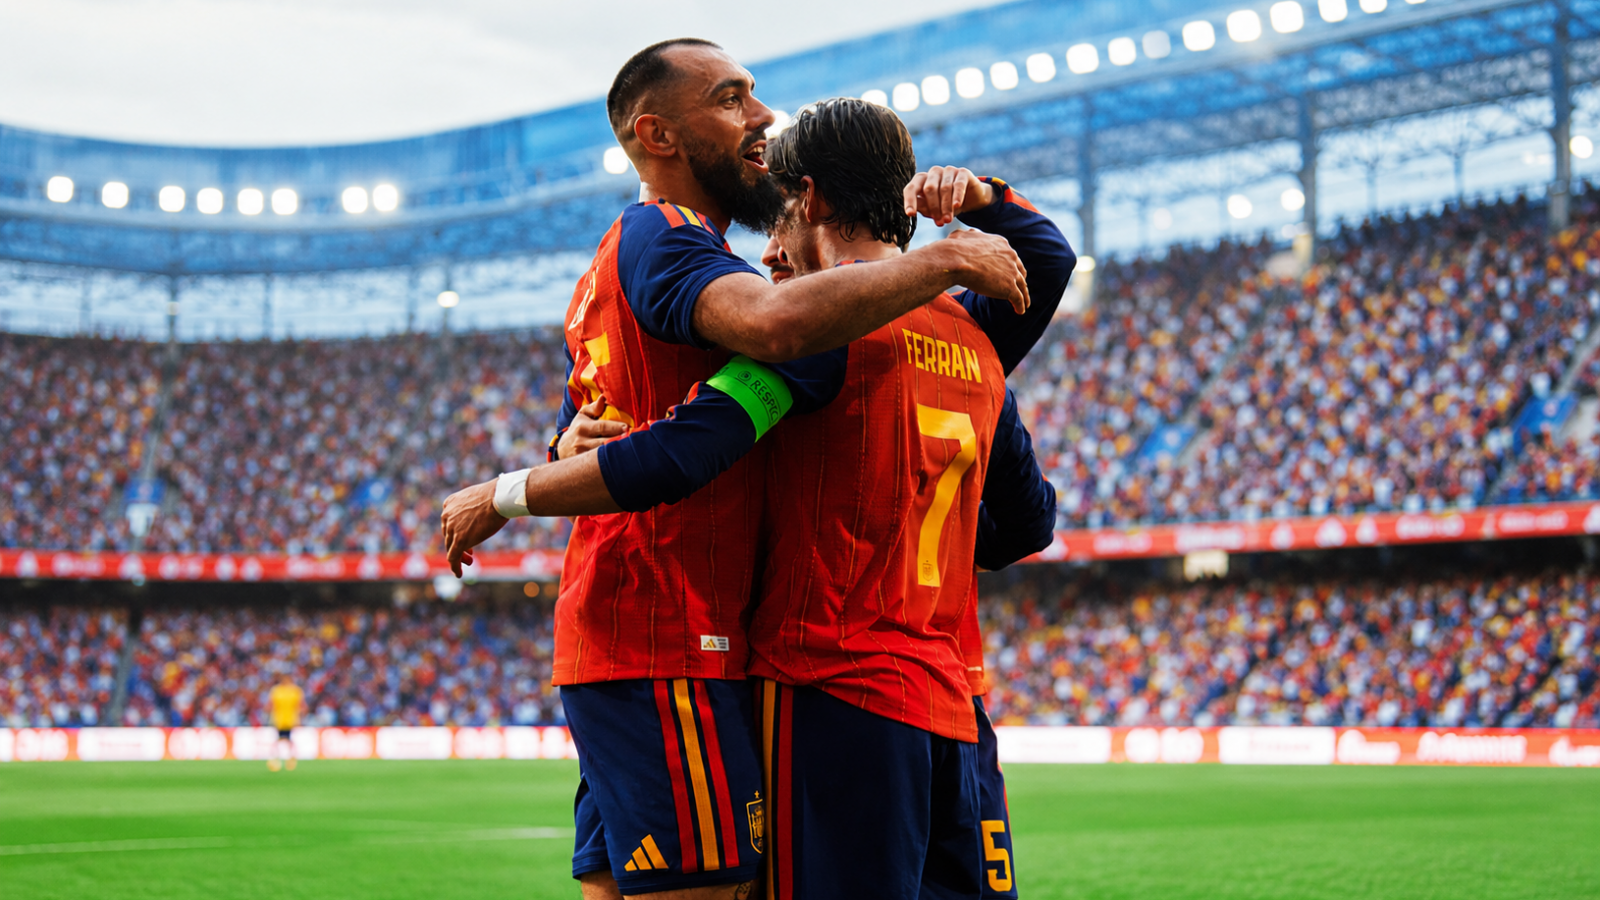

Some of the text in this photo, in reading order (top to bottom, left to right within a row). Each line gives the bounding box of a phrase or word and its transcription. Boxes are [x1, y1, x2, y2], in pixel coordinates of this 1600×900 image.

[901, 327, 982, 384] FERRAN
[750, 379, 779, 421] RESPEC
[916, 402, 977, 588] 7
[980, 819, 1013, 892] 5
